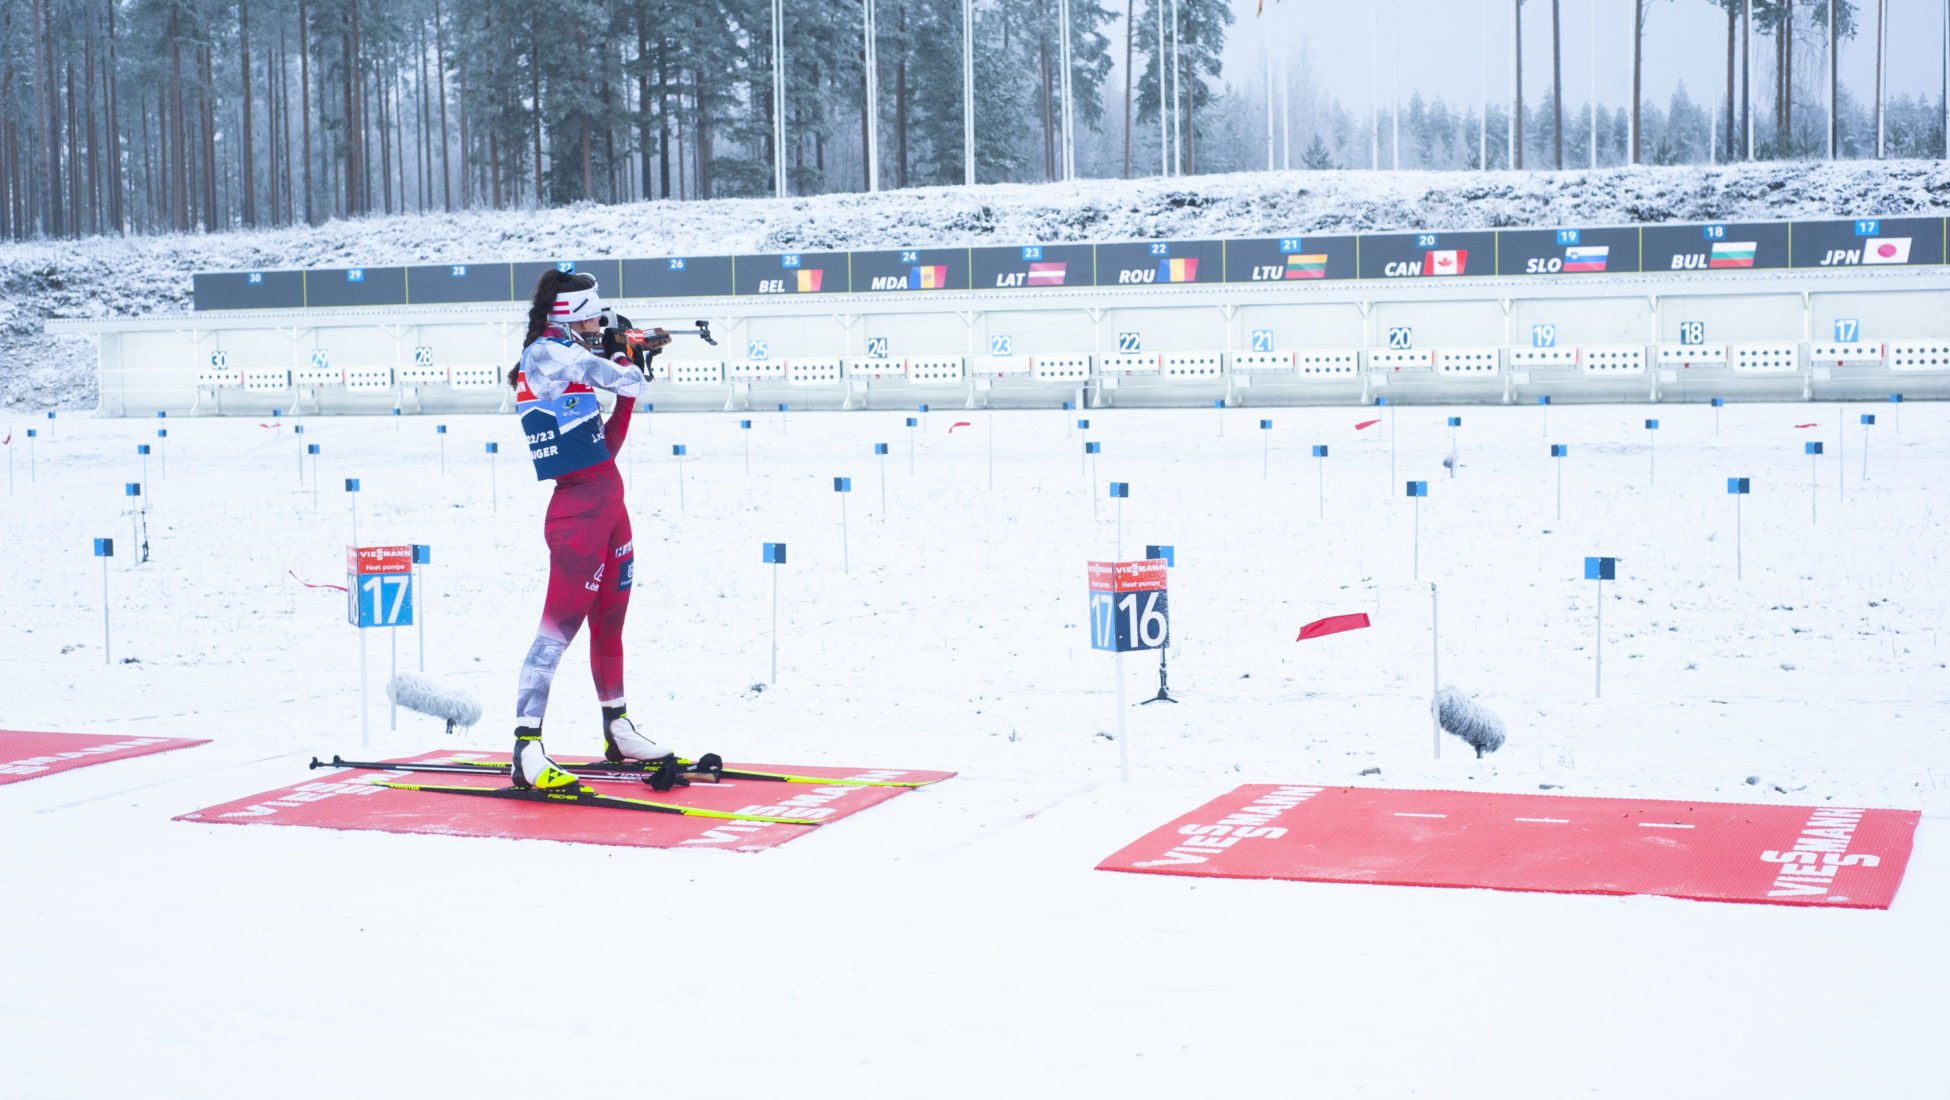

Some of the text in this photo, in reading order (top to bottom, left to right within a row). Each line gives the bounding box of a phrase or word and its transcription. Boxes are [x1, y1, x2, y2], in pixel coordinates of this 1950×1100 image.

[1707, 226, 1724, 237] 18
[1859, 222, 1876, 233] 17
[1419, 235, 1435, 245] 20
[1560, 231, 1577, 242] 19
[1151, 244, 1167, 254] 22
[1283, 239, 1298, 250] 21
[784, 256, 798, 265] 25
[902, 252, 917, 262] 24
[1025, 248, 1040, 258] 23
[1820, 249, 1861, 266] JPN
[559, 262, 572, 272] 27
[670, 259, 684, 269] 26
[1384, 261, 1422, 277] CAN
[1526, 257, 1562, 273] SLO
[1671, 254, 1708, 269] BUL
[250, 273, 261, 283] 30
[349, 270, 361, 279] 29
[453, 266, 465, 275] 28
[1119, 269, 1156, 284] ROU
[1252, 265, 1284, 280] LTU
[758, 280, 786, 293] BEL
[871, 276, 908, 290] MDA
[996, 273, 1026, 287] LAT
[1534, 325, 1554, 346] 19
[1682, 323, 1702, 344] 18
[1835, 320, 1857, 341] 17
[992, 336, 1011, 355] 23
[1120, 333, 1140, 353] 22
[1252, 331, 1272, 351] 21
[1390, 328, 1412, 349] 20
[750, 341, 767, 359] 25
[869, 338, 887, 357] 24
[212, 351, 228, 369] 30
[312, 350, 329, 368] 29
[416, 348, 432, 365] 28
[360, 548, 411, 560] VIESSMANN
[1115, 563, 1166, 577] VIESSMANN
[362, 575, 409, 625] 17
[1091, 593, 1113, 648] 17
[1118, 591, 1168, 648] 16
[1146, 786, 1324, 867] VIESSMANN
[1759, 807, 1881, 897] VIESSMANN
